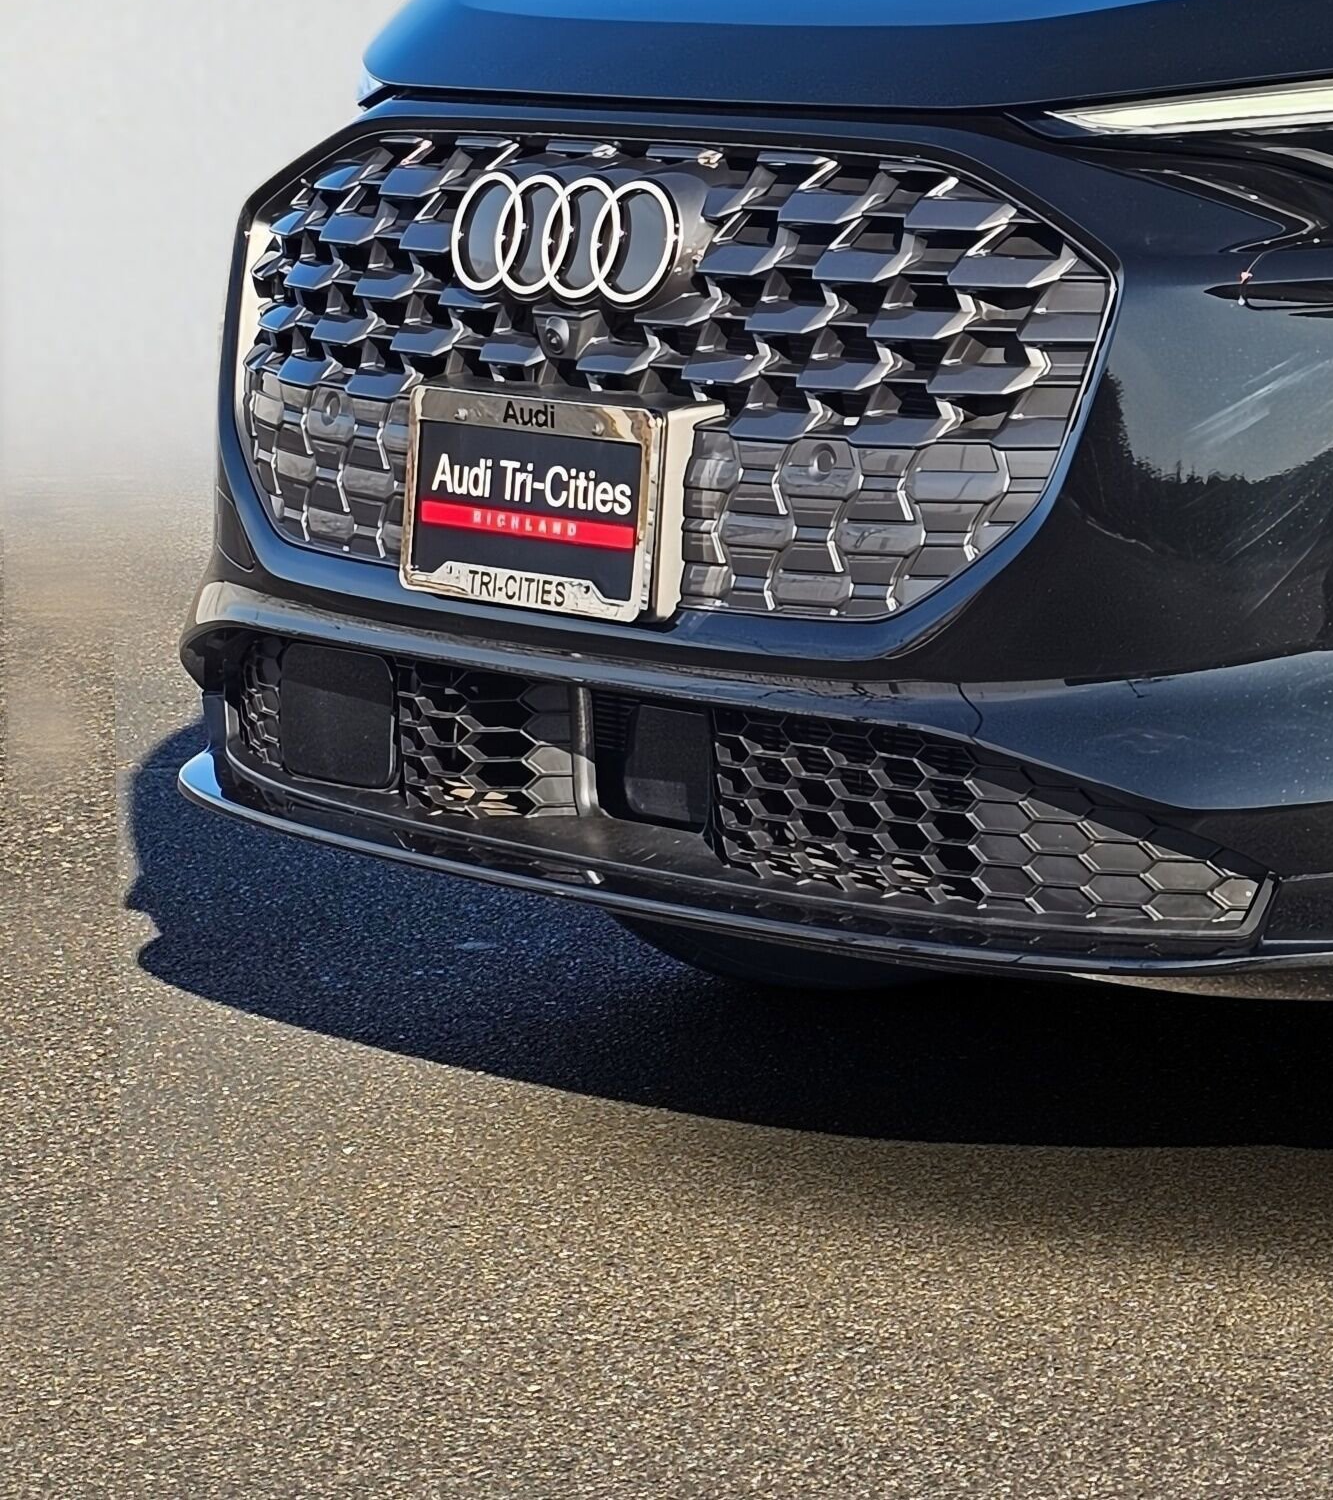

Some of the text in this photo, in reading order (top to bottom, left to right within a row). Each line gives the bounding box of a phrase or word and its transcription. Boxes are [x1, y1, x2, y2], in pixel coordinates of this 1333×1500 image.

[502, 400, 556, 429] Audi
[431, 452, 632, 516] Audi Tri-Cities
[472, 509, 578, 538] RICHLAND
[468, 569, 567, 608] TRI-CITIES
